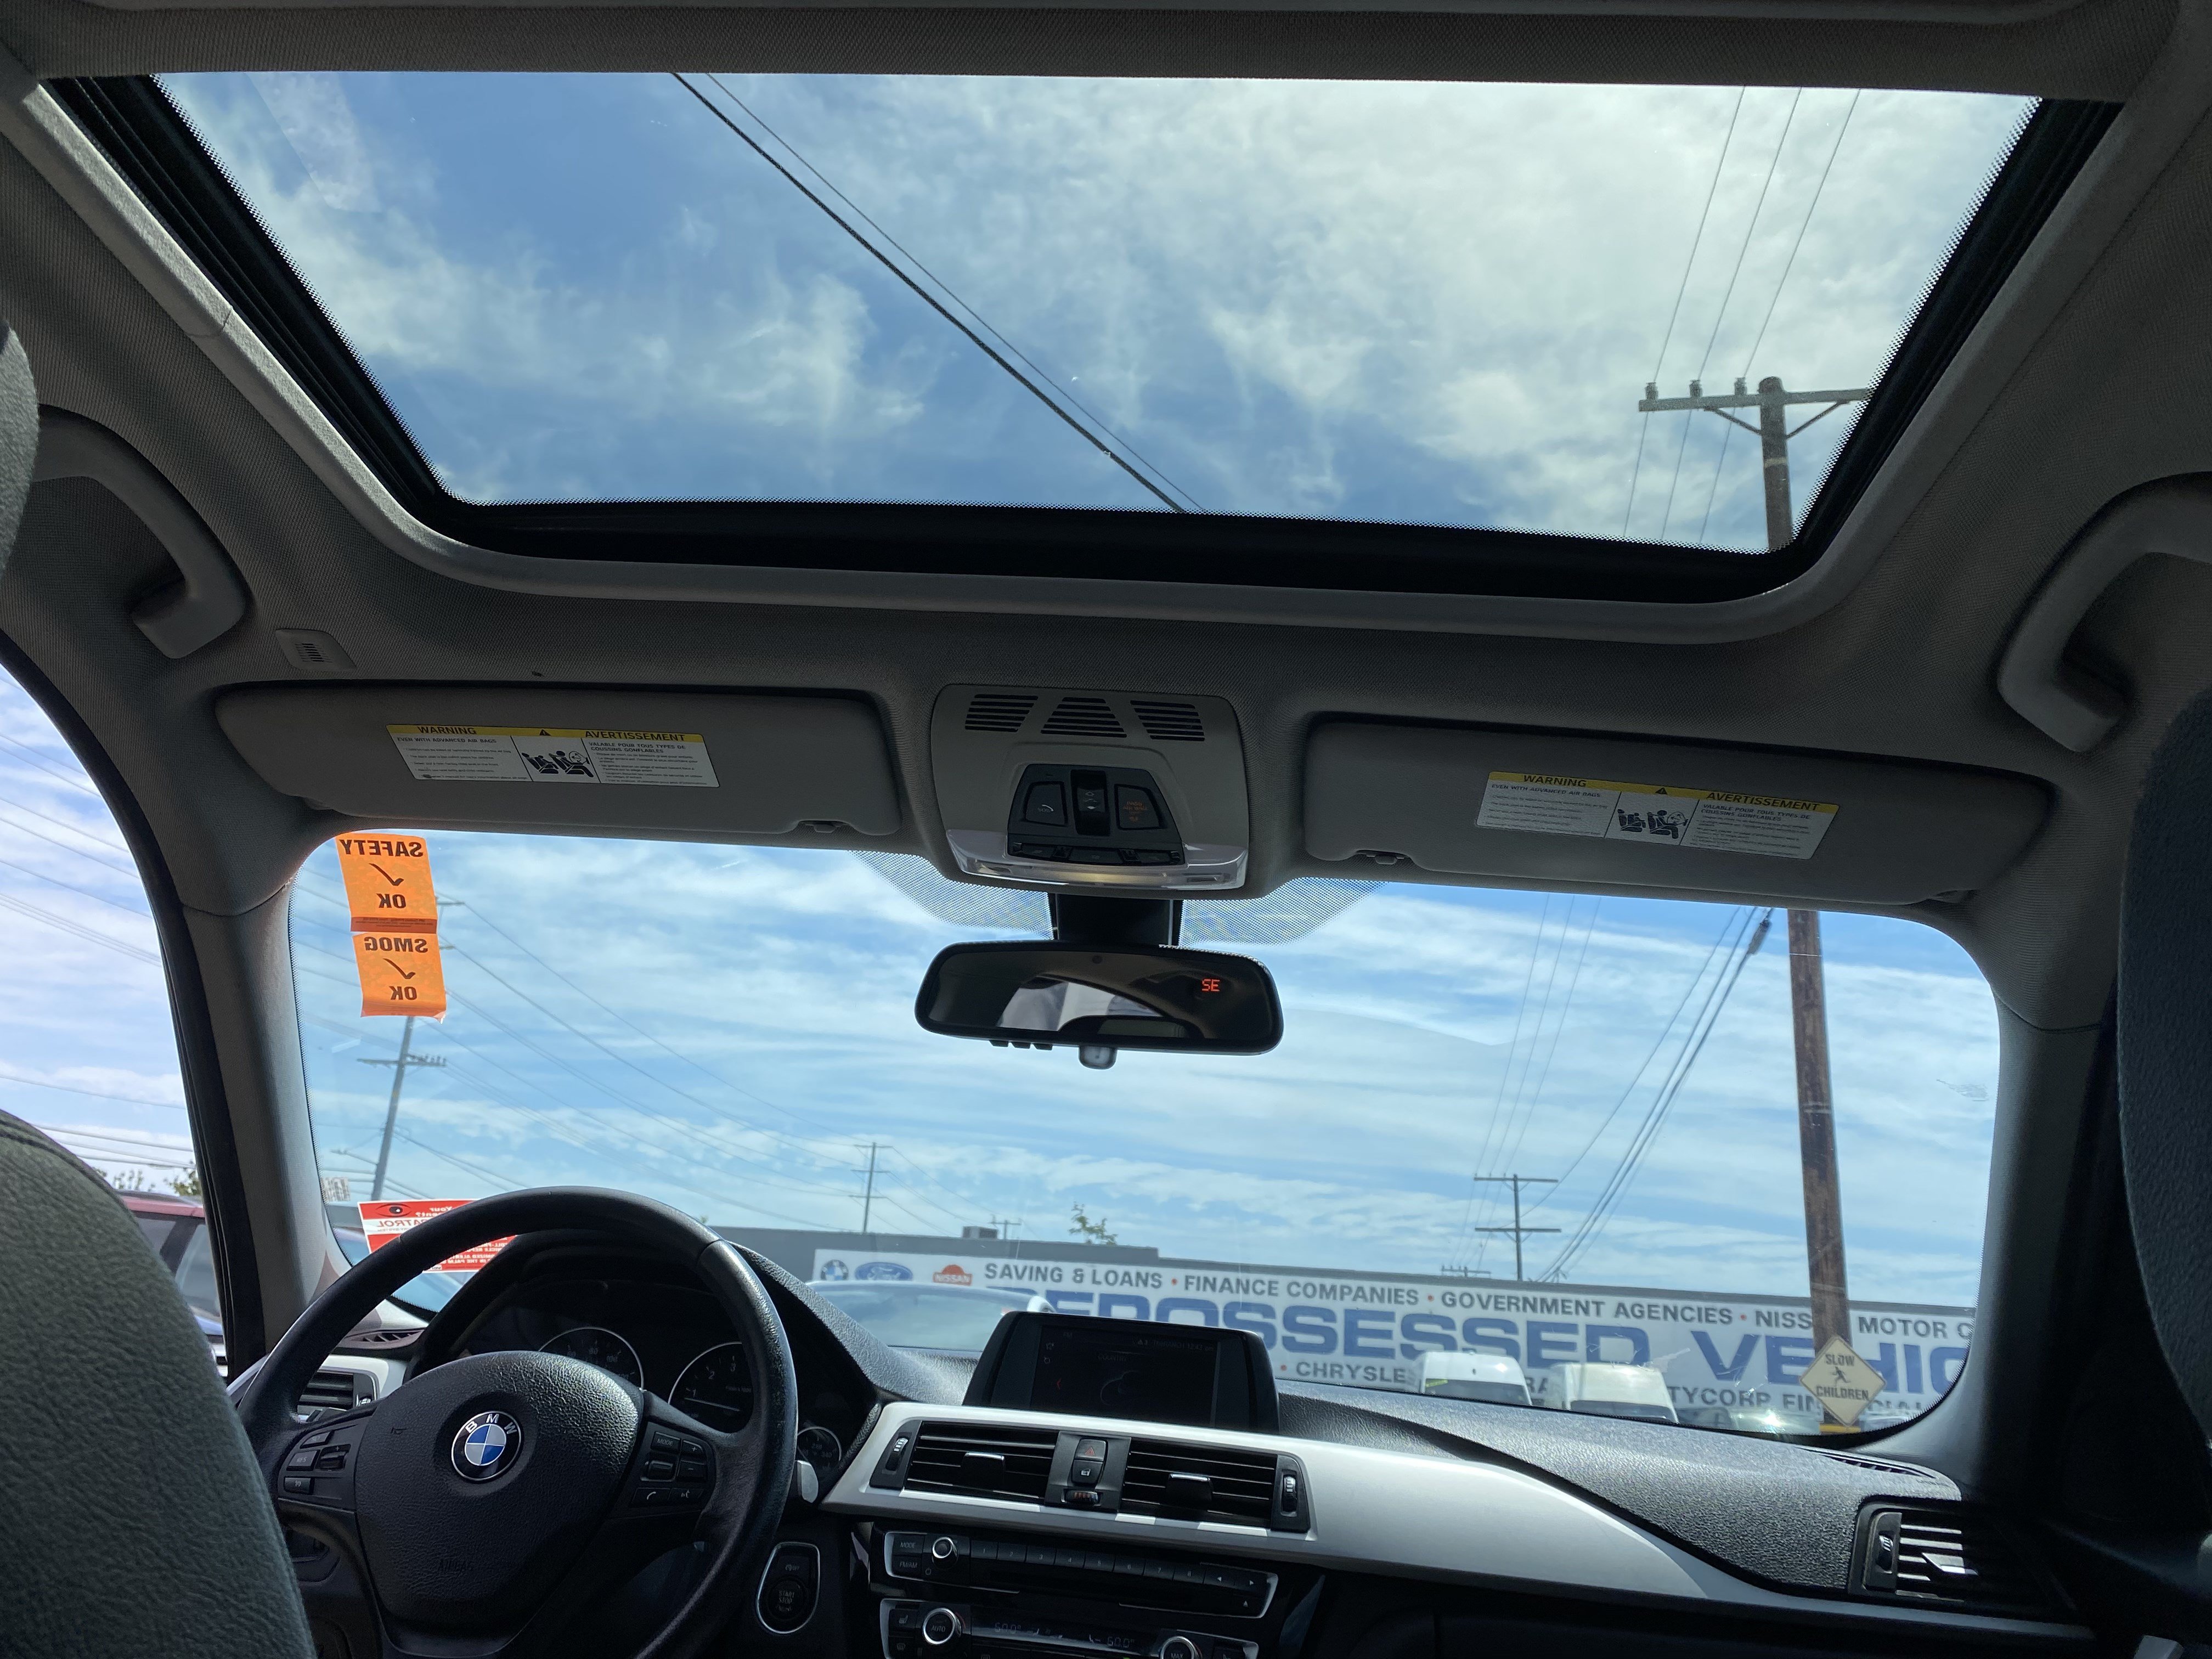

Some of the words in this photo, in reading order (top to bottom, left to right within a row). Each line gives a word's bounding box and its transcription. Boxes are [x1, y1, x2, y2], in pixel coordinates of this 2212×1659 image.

[417, 726, 477, 735] WARNING
[585, 731, 685, 741] AVERTISSEMENT
[1523, 775, 1587, 787] WARNING
[1706, 792, 1820, 811] AVERTISSEMENT
[1737, 812, 1781, 822] GONFLABLES
[1202, 979, 1220, 991] SE
[985, 1263, 1063, 1283] SAVING
[1073, 1267, 1084, 1283] &
[1092, 1268, 1163, 1289] LOANS
[1184, 1275, 1279, 1297] FINANCE
[1286, 1282, 1419, 1305] COMPANIES
[1441, 1291, 1605, 1317] GOVERNMENT
[1615, 1302, 1734, 1325] AGENCIES
[1755, 1310, 1813, 1329] NISS
[1859, 1316, 1948, 1339] MOTOR
[986, 1286, 1651, 1369] EPOSSESSED
[1825, 1353, 1855, 1367] SLOW
[708, 1371, 715, 1379] 2
[1296, 1361, 1407, 1384] CHRYSLE
[1816, 1385, 1869, 1401] CHILDREN
[465, 1413, 517, 1435] BMW
[657, 1438, 674, 1447] MODE
[931, 1625, 946, 1633] AUTO
